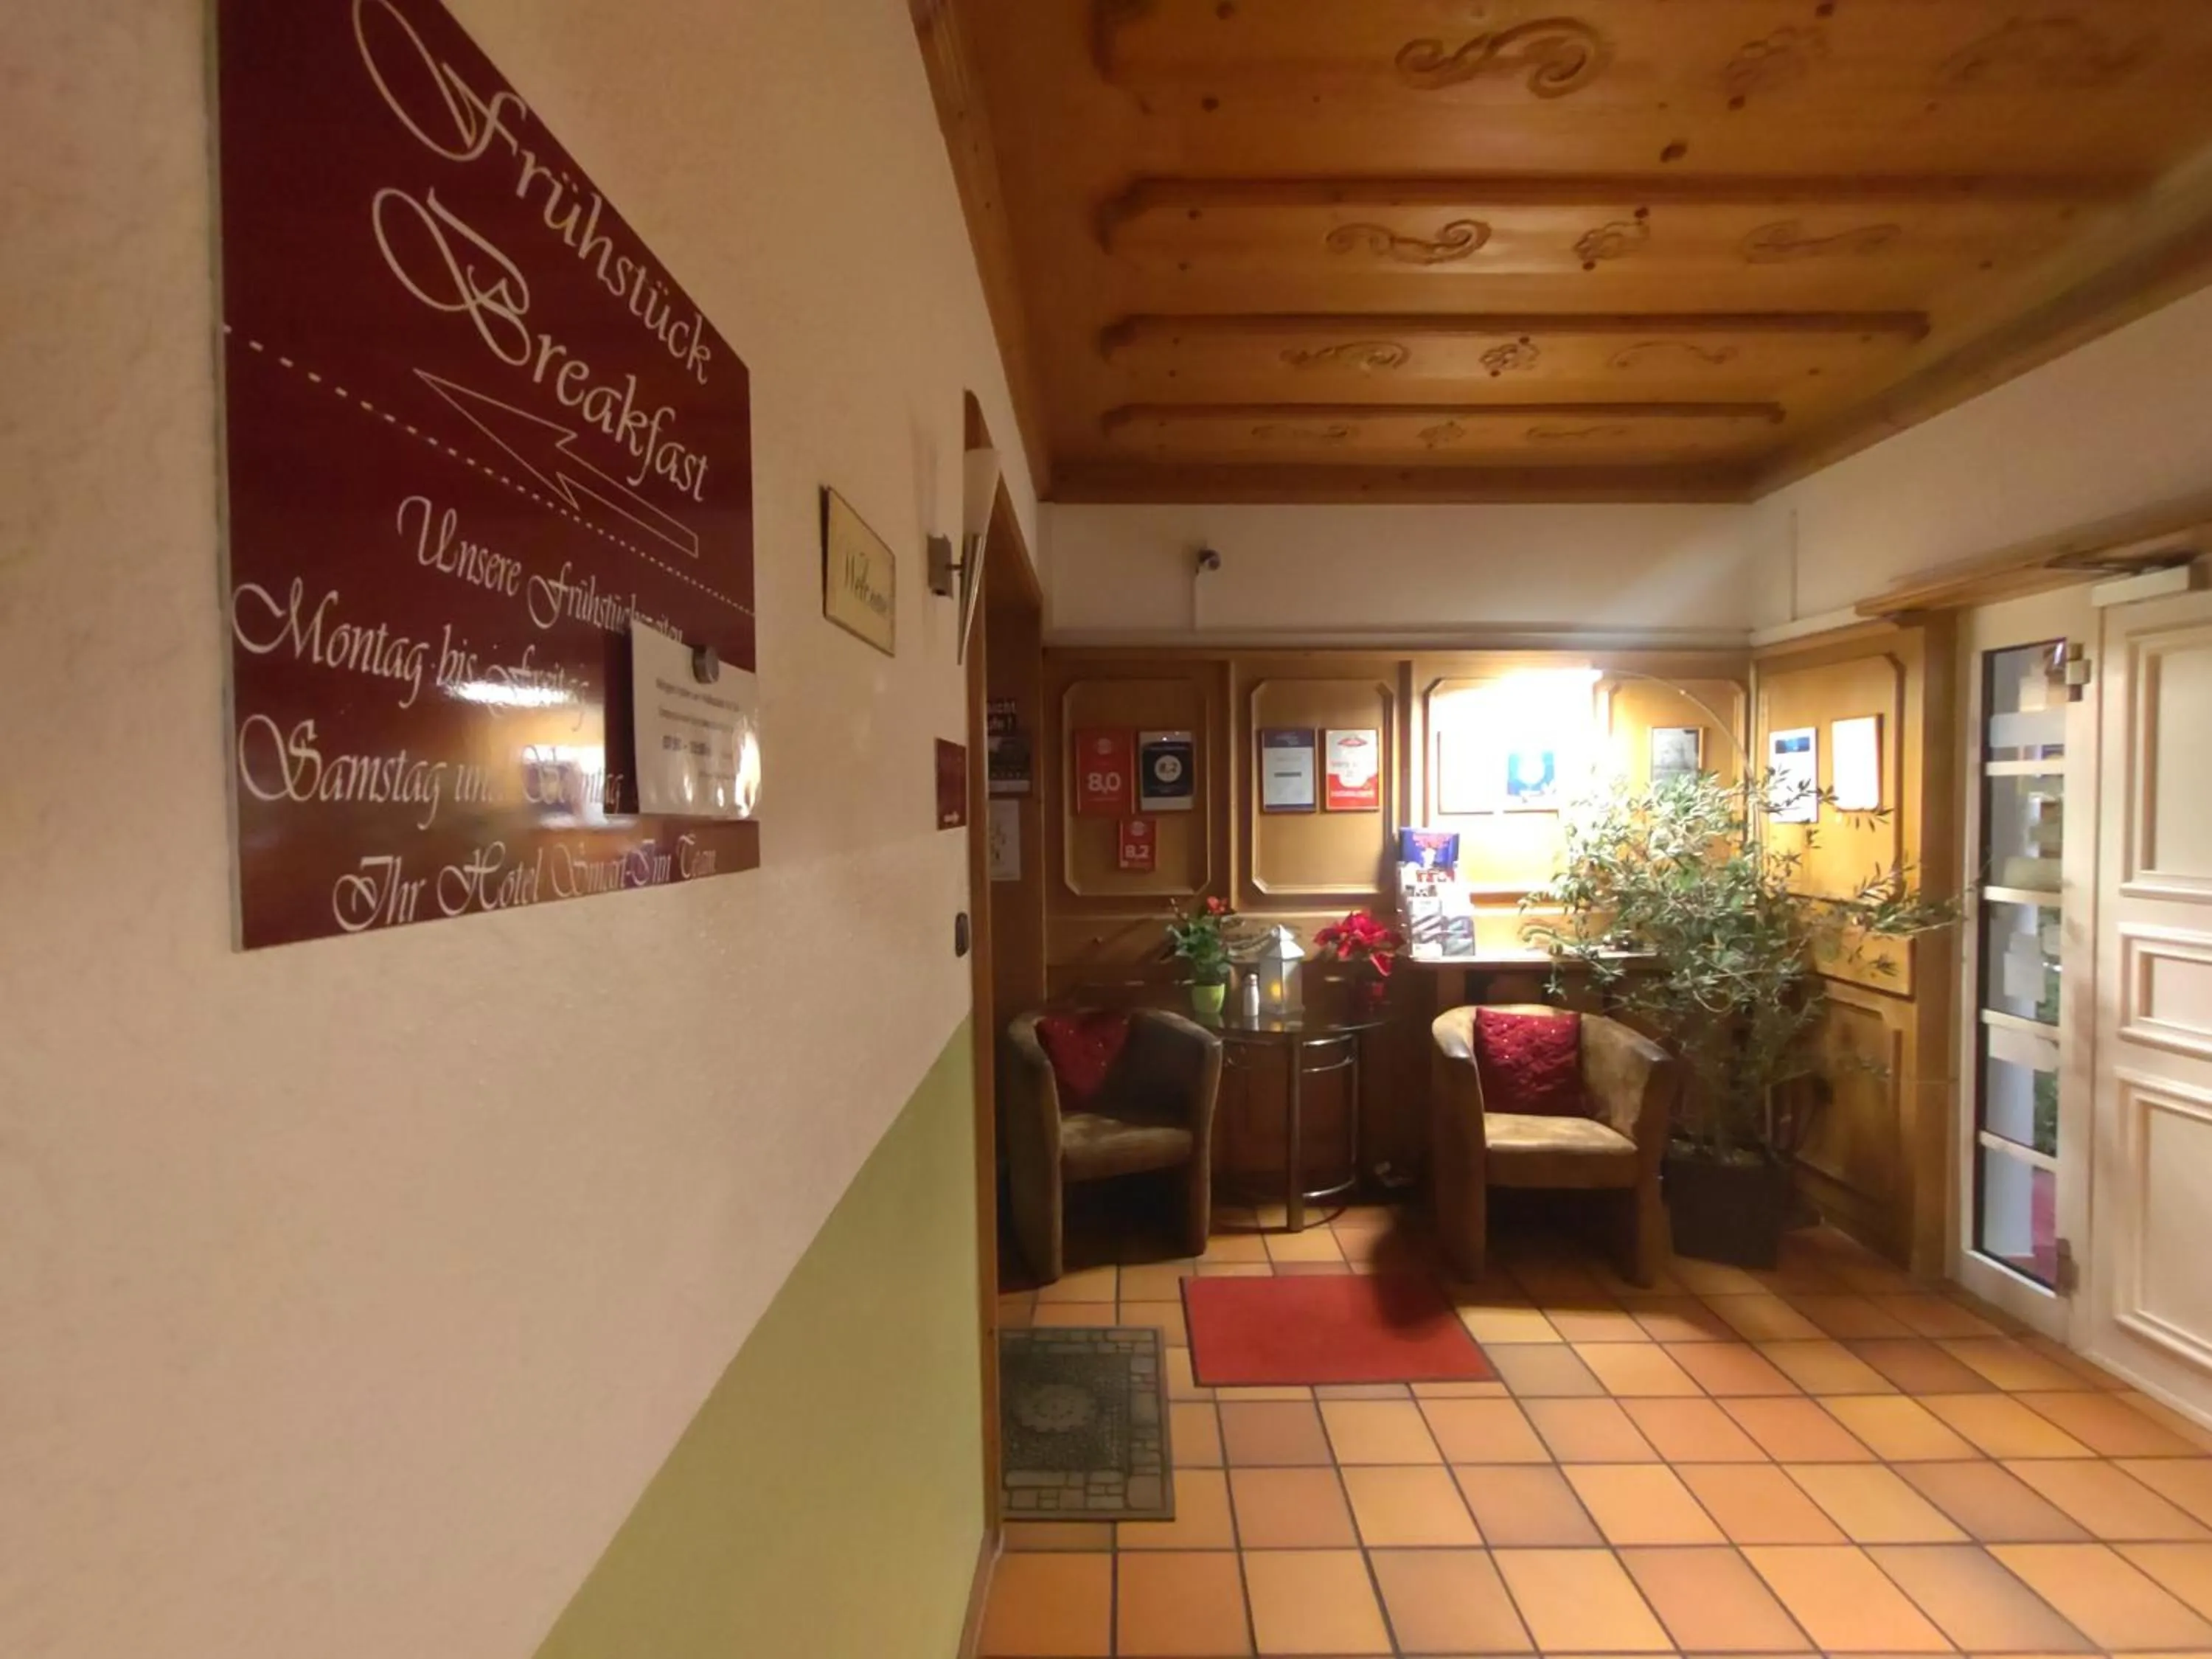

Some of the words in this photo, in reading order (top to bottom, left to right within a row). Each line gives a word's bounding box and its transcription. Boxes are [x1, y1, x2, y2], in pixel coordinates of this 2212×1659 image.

[352, 0, 712, 384] Frühstück
[372, 187, 709, 501] Breakfast
[397, 495, 521, 597] Unsere
[232, 576, 429, 709] Montag
[436, 625, 479, 686] bis
[239, 714, 448, 830] Samstag
[453, 762, 505, 803] un
[1088, 771, 1121, 795] 8,0
[333, 856, 426, 932] Ihr
[437, 841, 542, 917] Hotel
